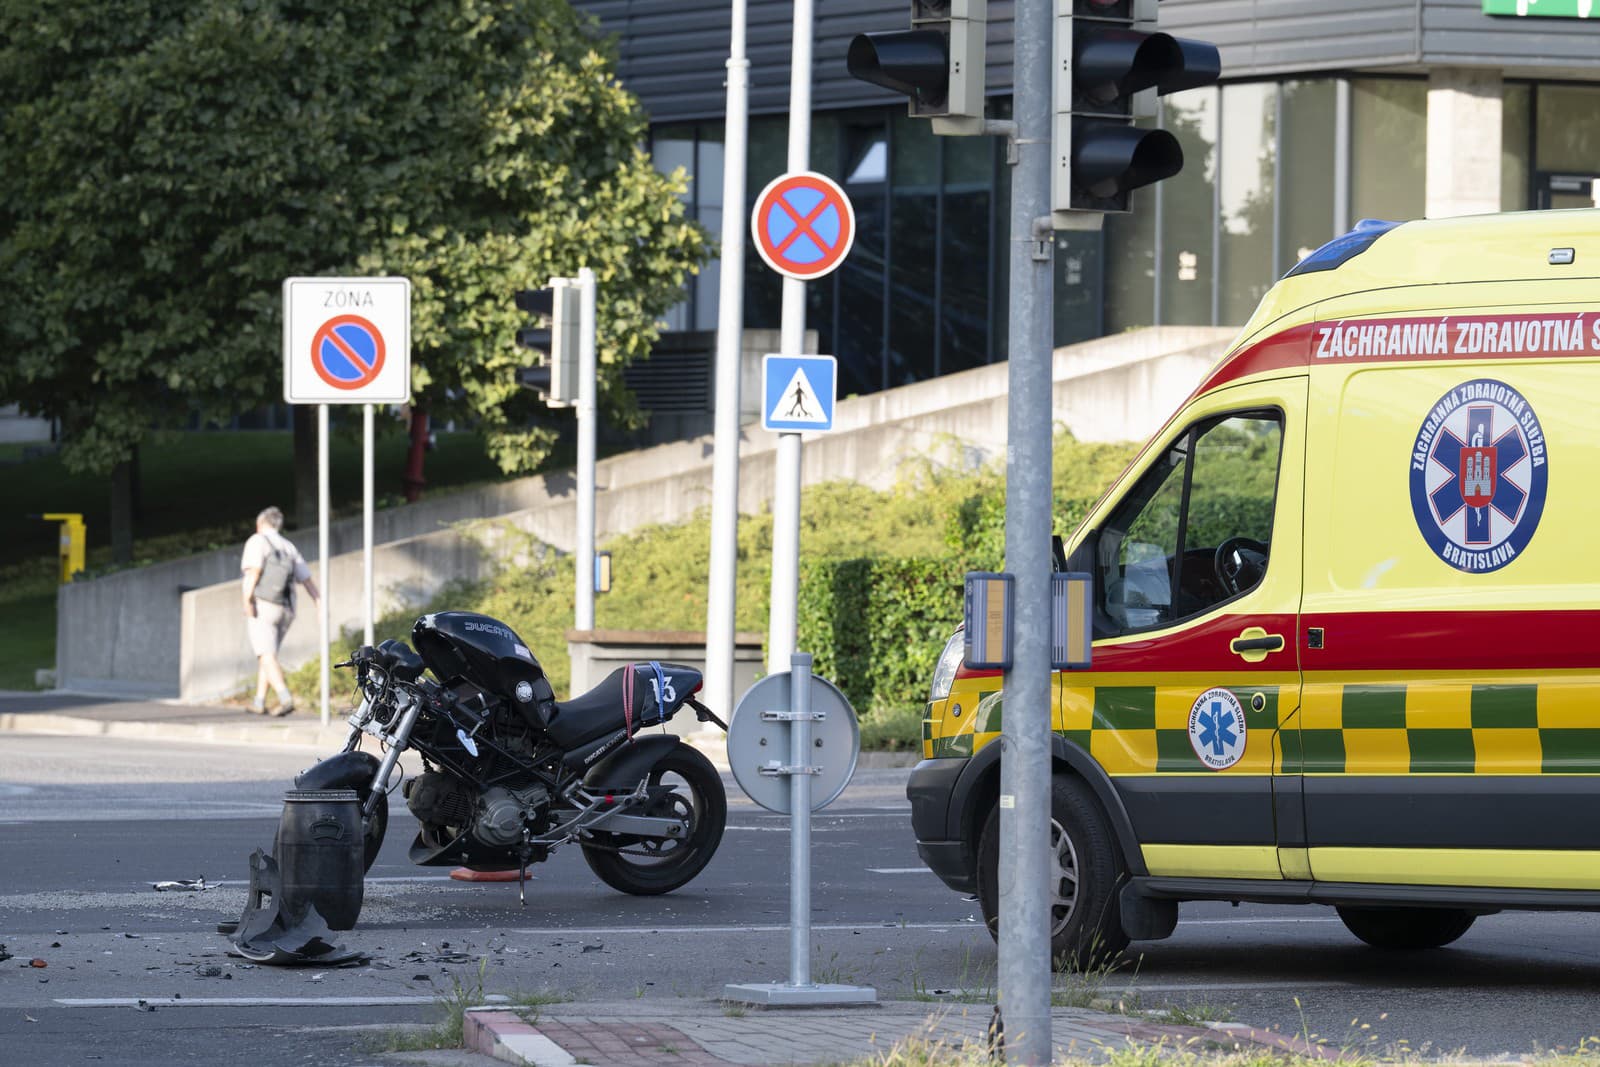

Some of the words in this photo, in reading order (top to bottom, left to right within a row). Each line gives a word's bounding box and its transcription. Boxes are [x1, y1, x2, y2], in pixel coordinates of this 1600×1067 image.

[1316, 317, 1449, 358] ZÁCHRANNÁ
[1454, 312, 1585, 354] ZDRAVOTNÁ
[1413, 389, 1461, 471] ZÁCHRANNÁ
[1460, 383, 1526, 417] ZDRAVOTNÁ
[1520, 411, 1545, 468] SLUŽBA
[1442, 541, 1516, 569] BRATISLAVA
[464, 621, 513, 640] DUCATI
